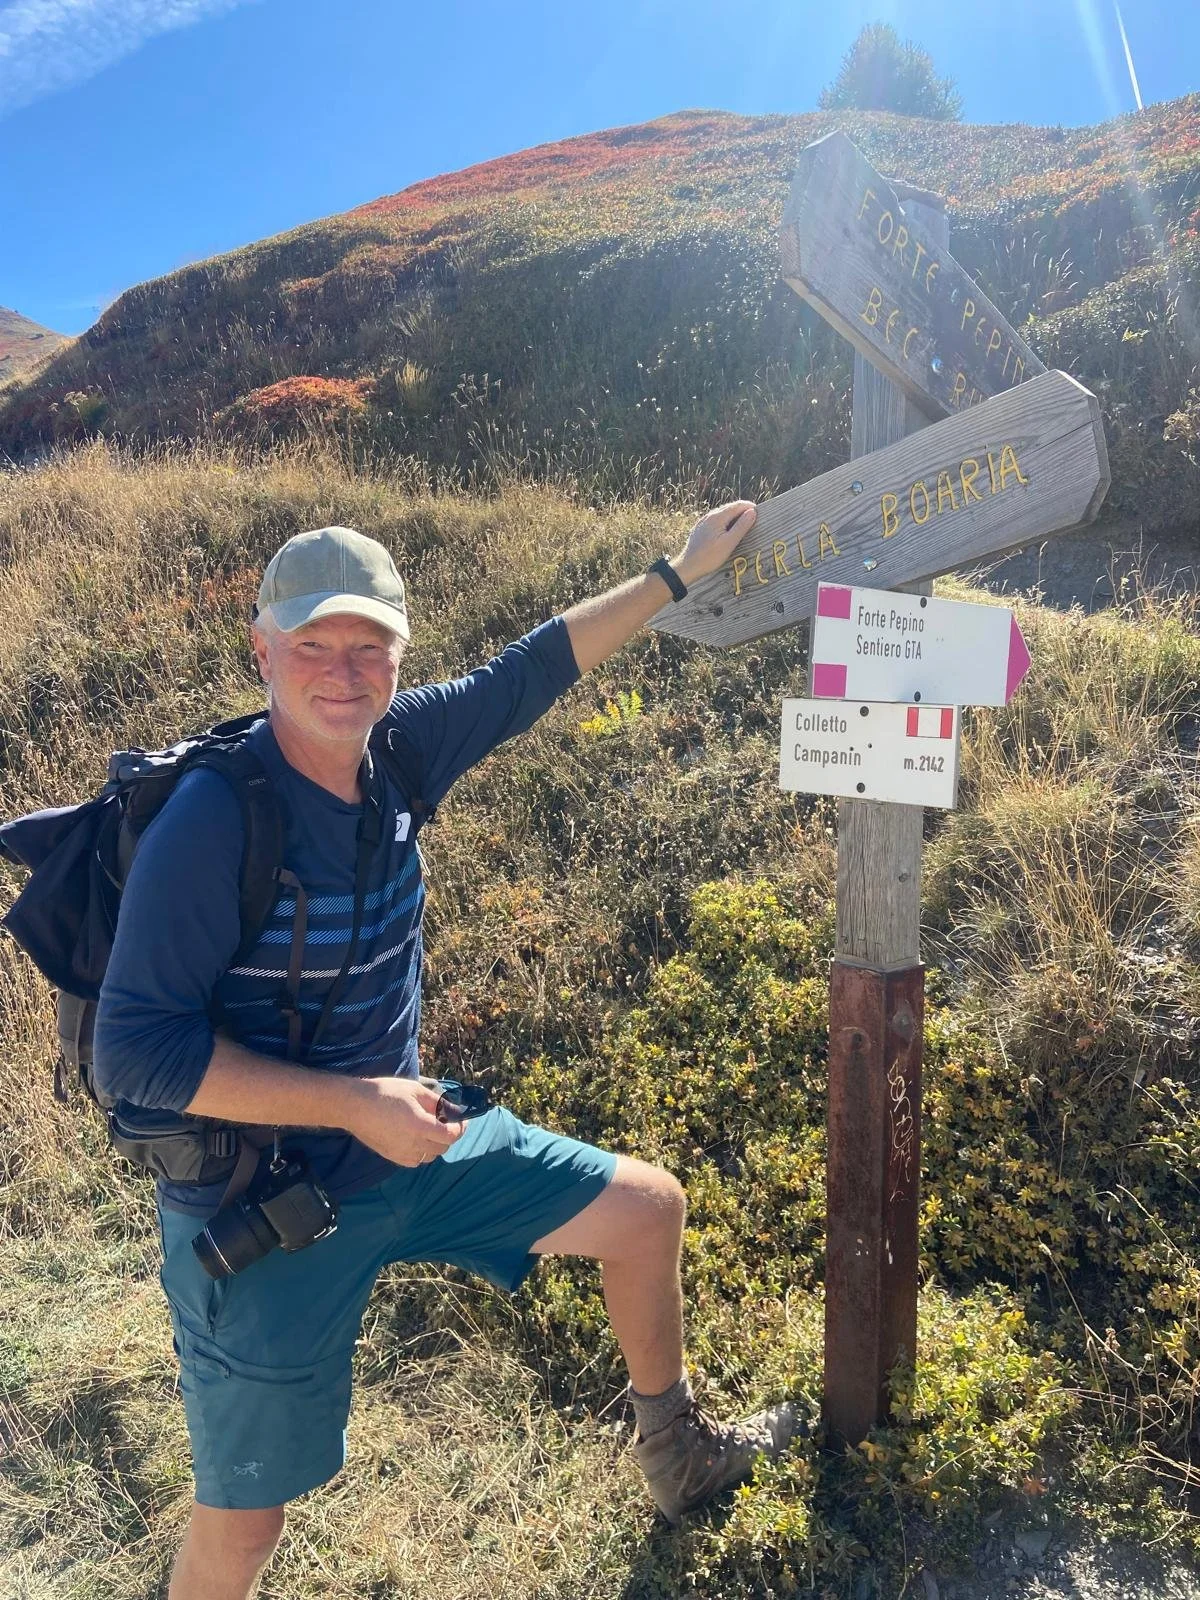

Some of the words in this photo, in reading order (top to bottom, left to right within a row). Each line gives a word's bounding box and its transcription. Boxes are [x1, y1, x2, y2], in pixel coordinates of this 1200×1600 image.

[858, 190, 939, 293] FORTE
[733, 522, 841, 596] PERLA
[880, 443, 1028, 539] BOARIA
[858, 605, 886, 629] Forte
[889, 611, 925, 635] Pepino
[856, 634, 901, 658] Sentiero
[904, 640, 922, 660] GTA
[795, 712, 848, 734] Colletto
[794, 743, 862, 768] Campanin
[903, 755, 945, 774] m.2142
